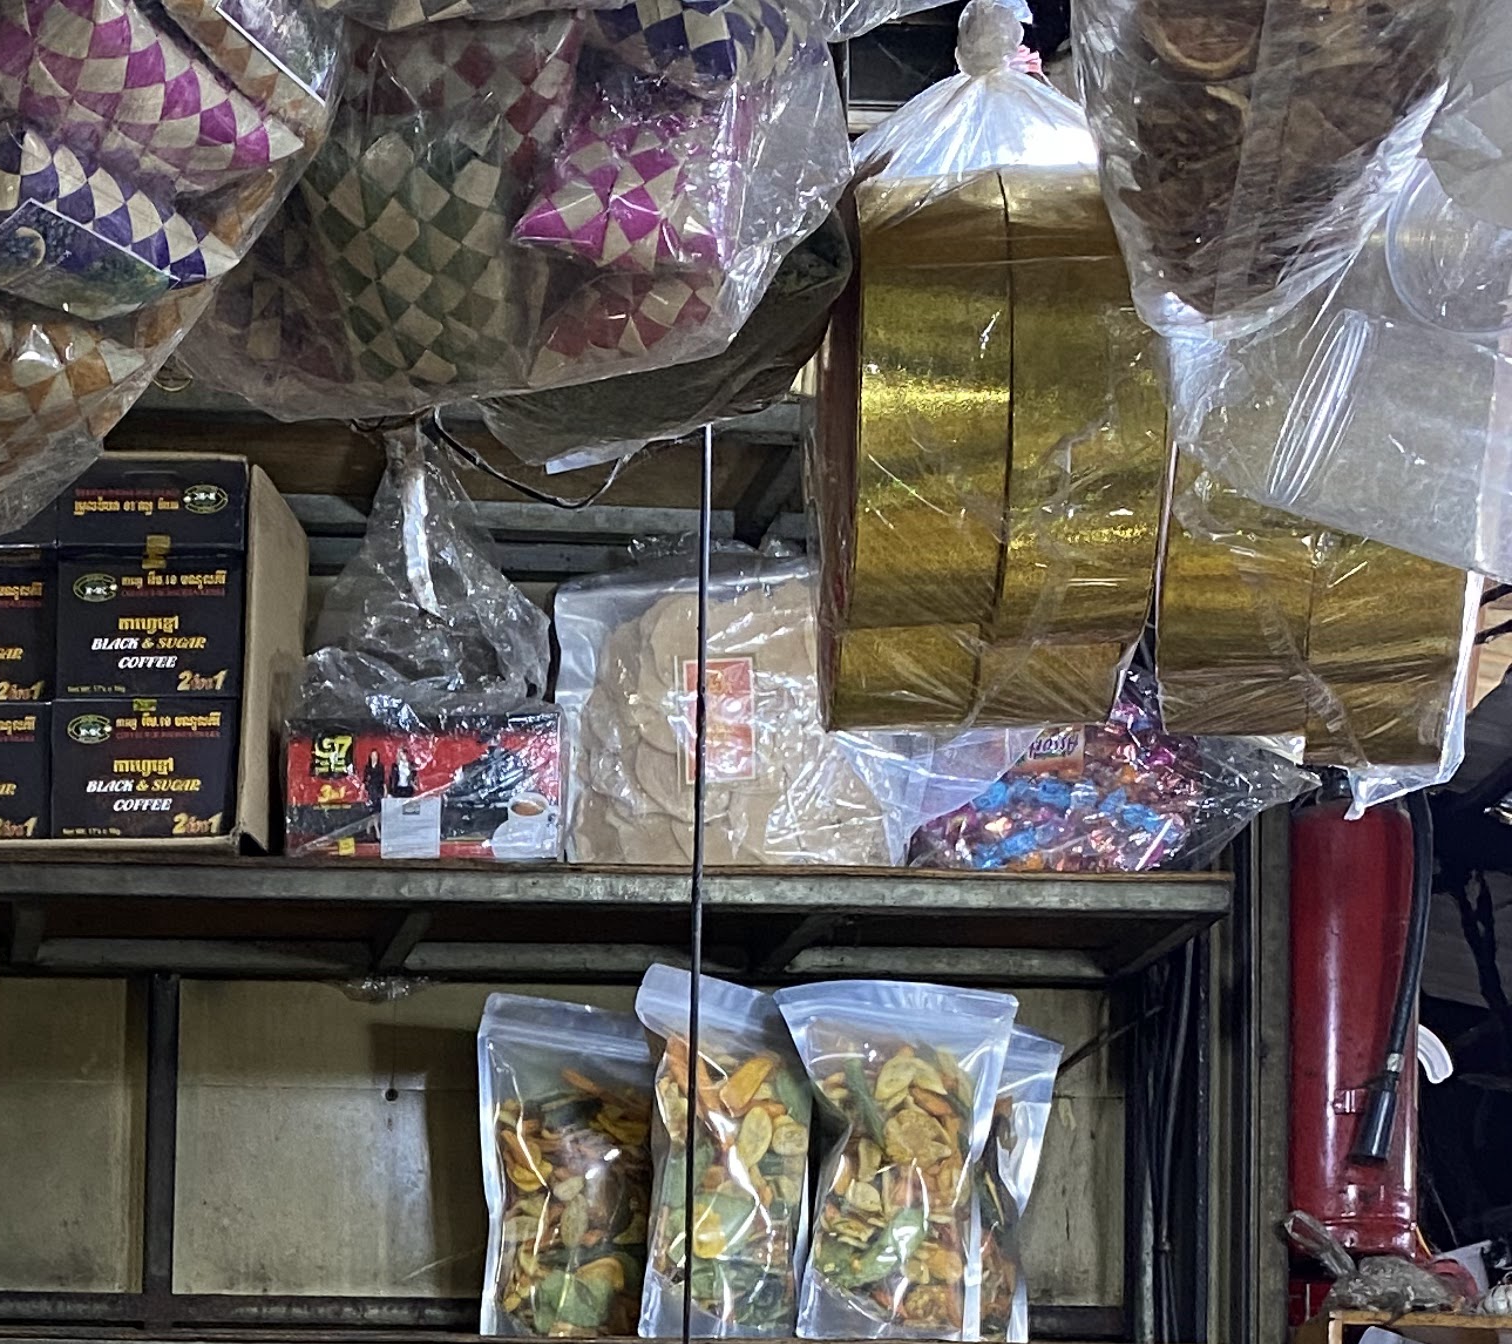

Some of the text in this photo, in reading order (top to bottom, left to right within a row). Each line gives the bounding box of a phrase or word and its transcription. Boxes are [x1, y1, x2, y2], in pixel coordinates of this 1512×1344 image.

[91, 637, 207, 650] BLACK & SUGAR
[118, 655, 178, 669] COFFEE
[314, 735, 353, 759] G7
[86, 779, 201, 793] BLACK & SUGAR
[113, 798, 173, 811] COFFEE
